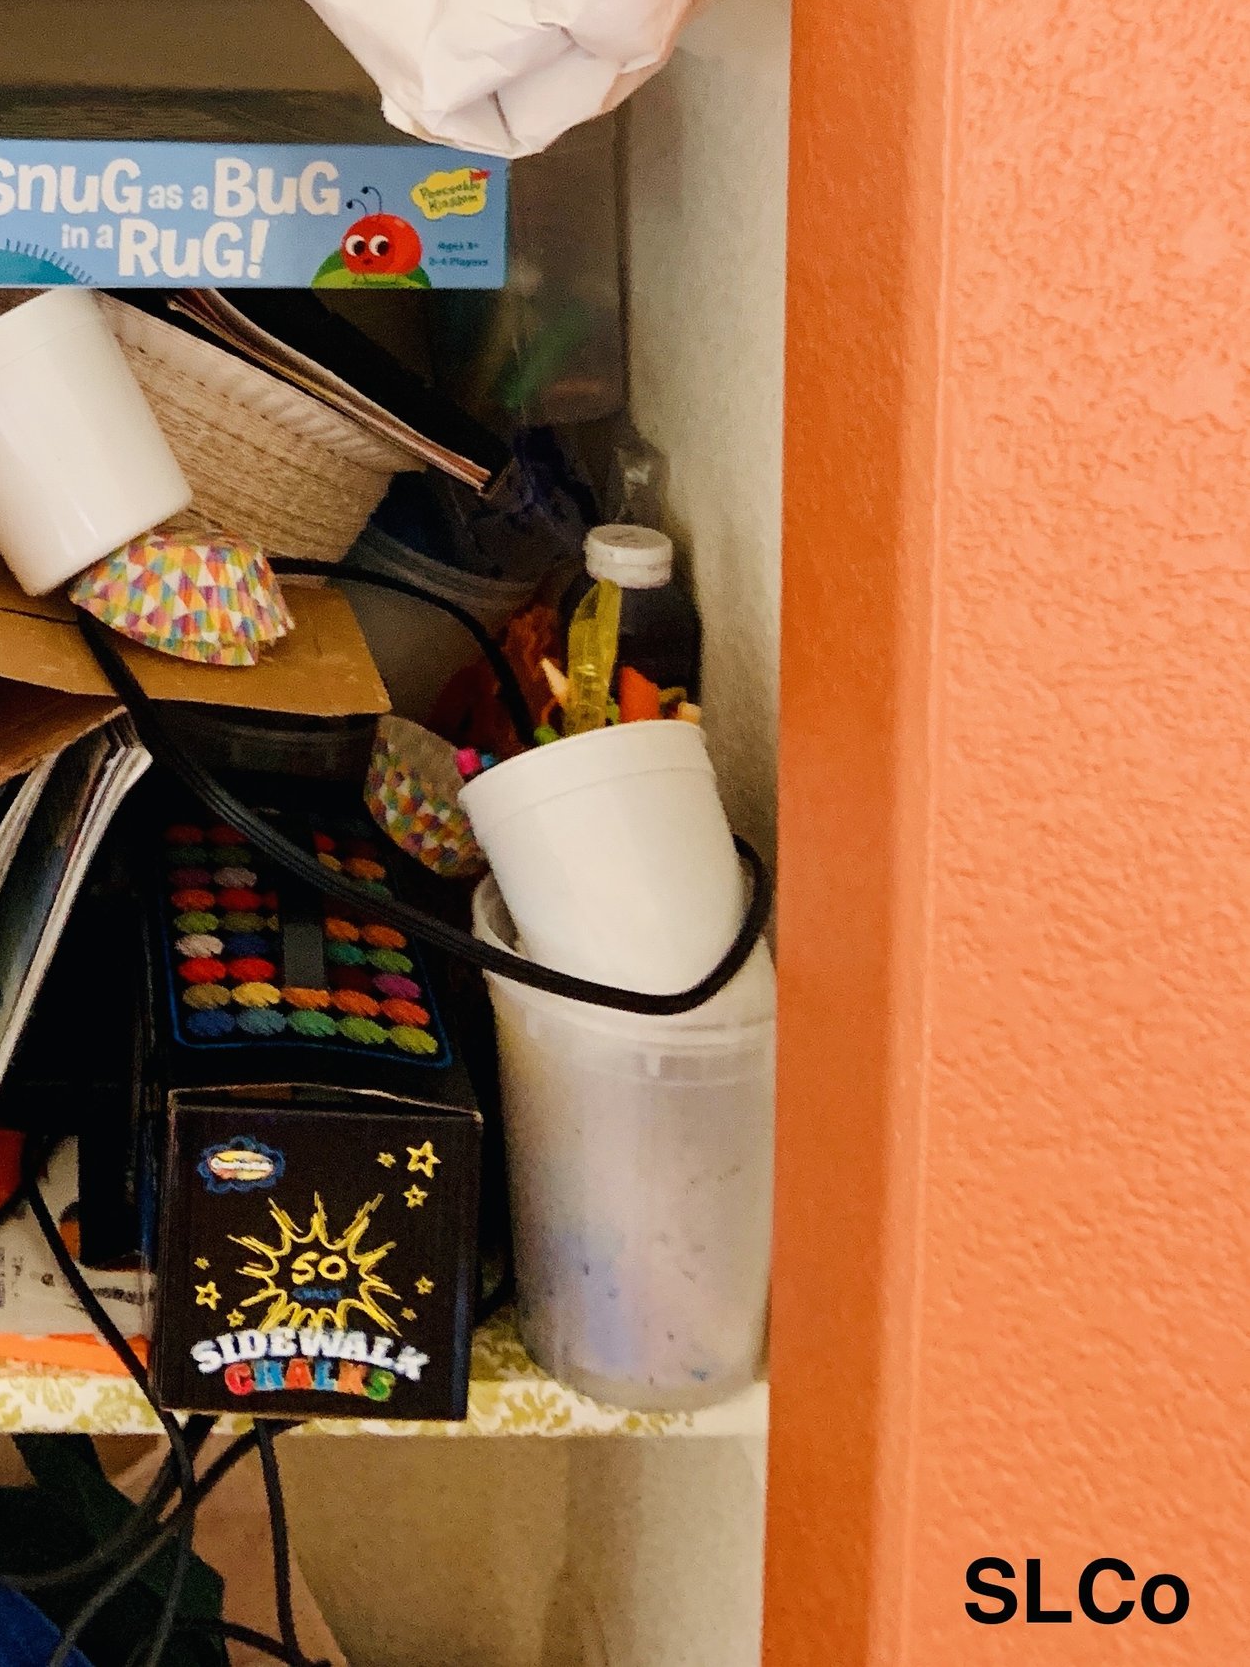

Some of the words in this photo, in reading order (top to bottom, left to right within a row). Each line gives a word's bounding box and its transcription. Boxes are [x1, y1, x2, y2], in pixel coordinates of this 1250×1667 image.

[148, 184, 183, 210] as
[191, 185, 208, 210] a
[61, 222, 89, 249] in
[96, 225, 113, 249] a
[291, 1251, 349, 1285] 50
[190, 1327, 431, 1382] SIDEWALK
[224, 1357, 396, 1403] CHALKS
